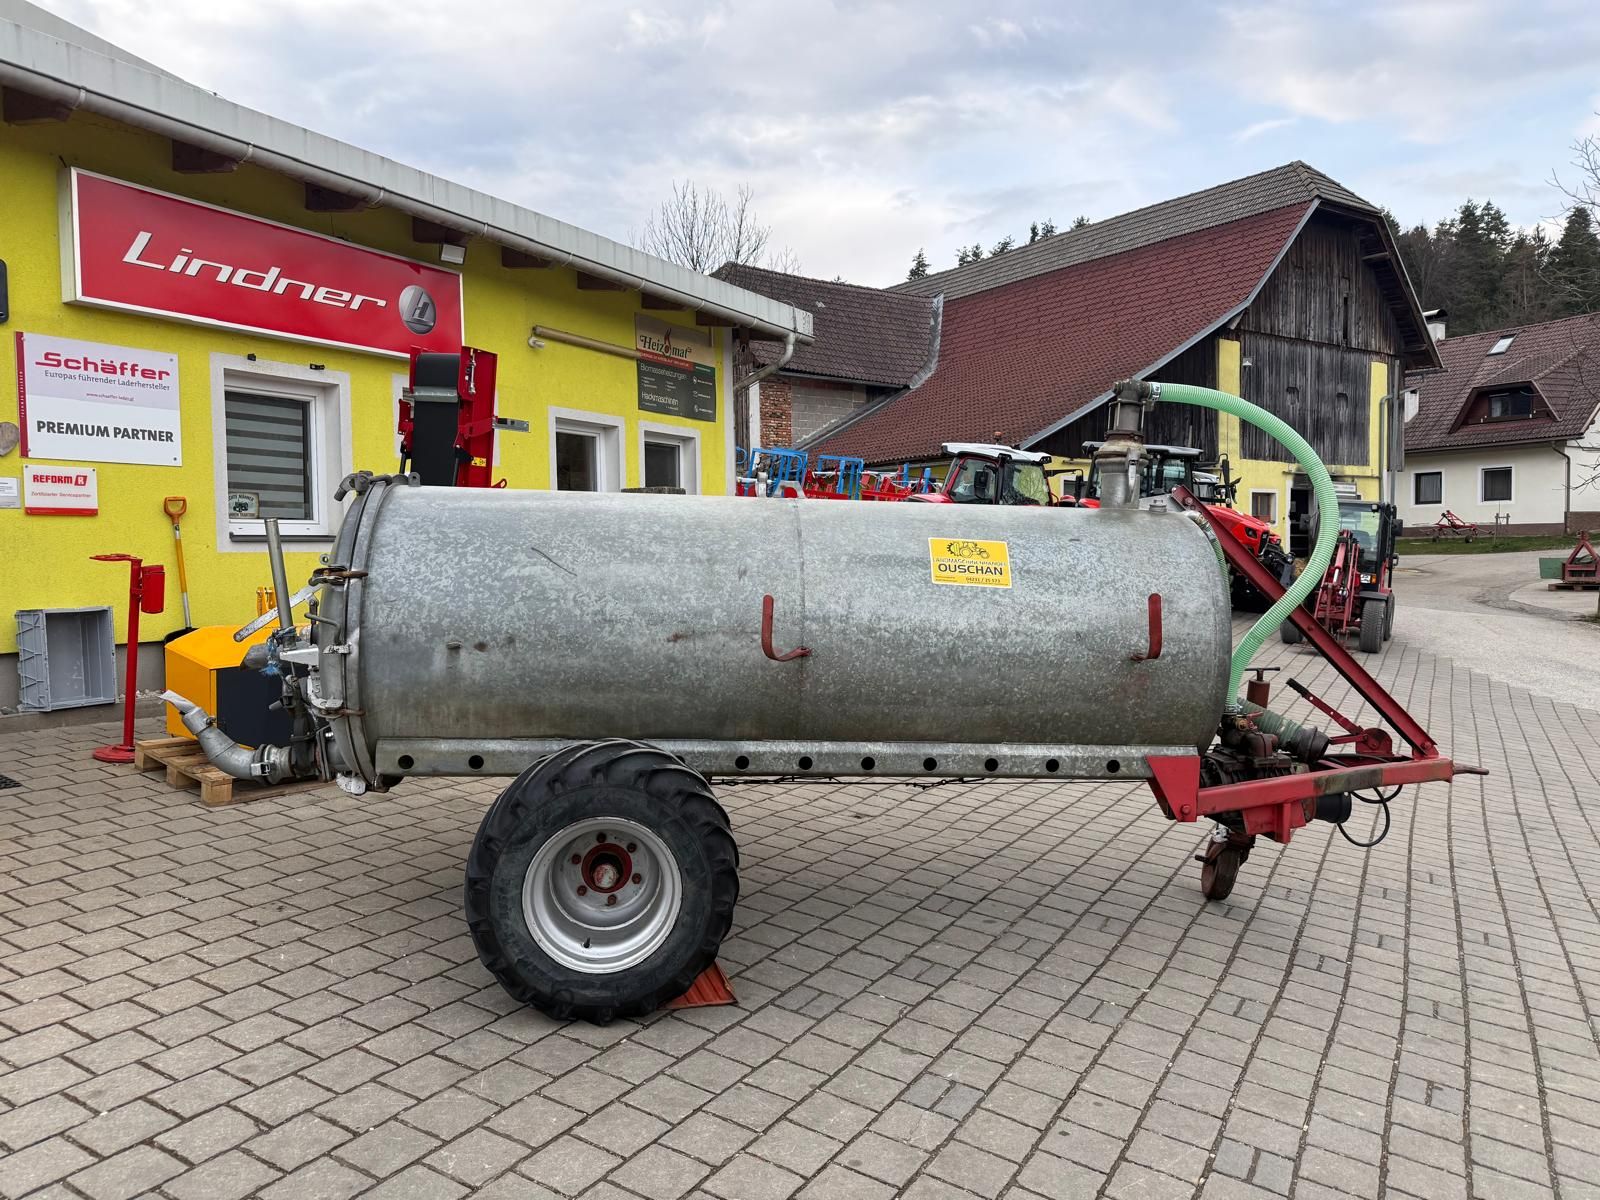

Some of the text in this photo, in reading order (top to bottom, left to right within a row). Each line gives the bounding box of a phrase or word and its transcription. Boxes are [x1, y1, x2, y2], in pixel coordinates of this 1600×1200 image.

[122, 231, 387, 311] Lindner
[35, 351, 170, 380] Schäffer
[44, 369, 170, 391] Europas führender Laderhersteller
[36, 420, 174, 443] PREMIUM PARTNER
[32, 474, 73, 485] REFORM
[938, 563, 1003, 576] OUSCHAN
